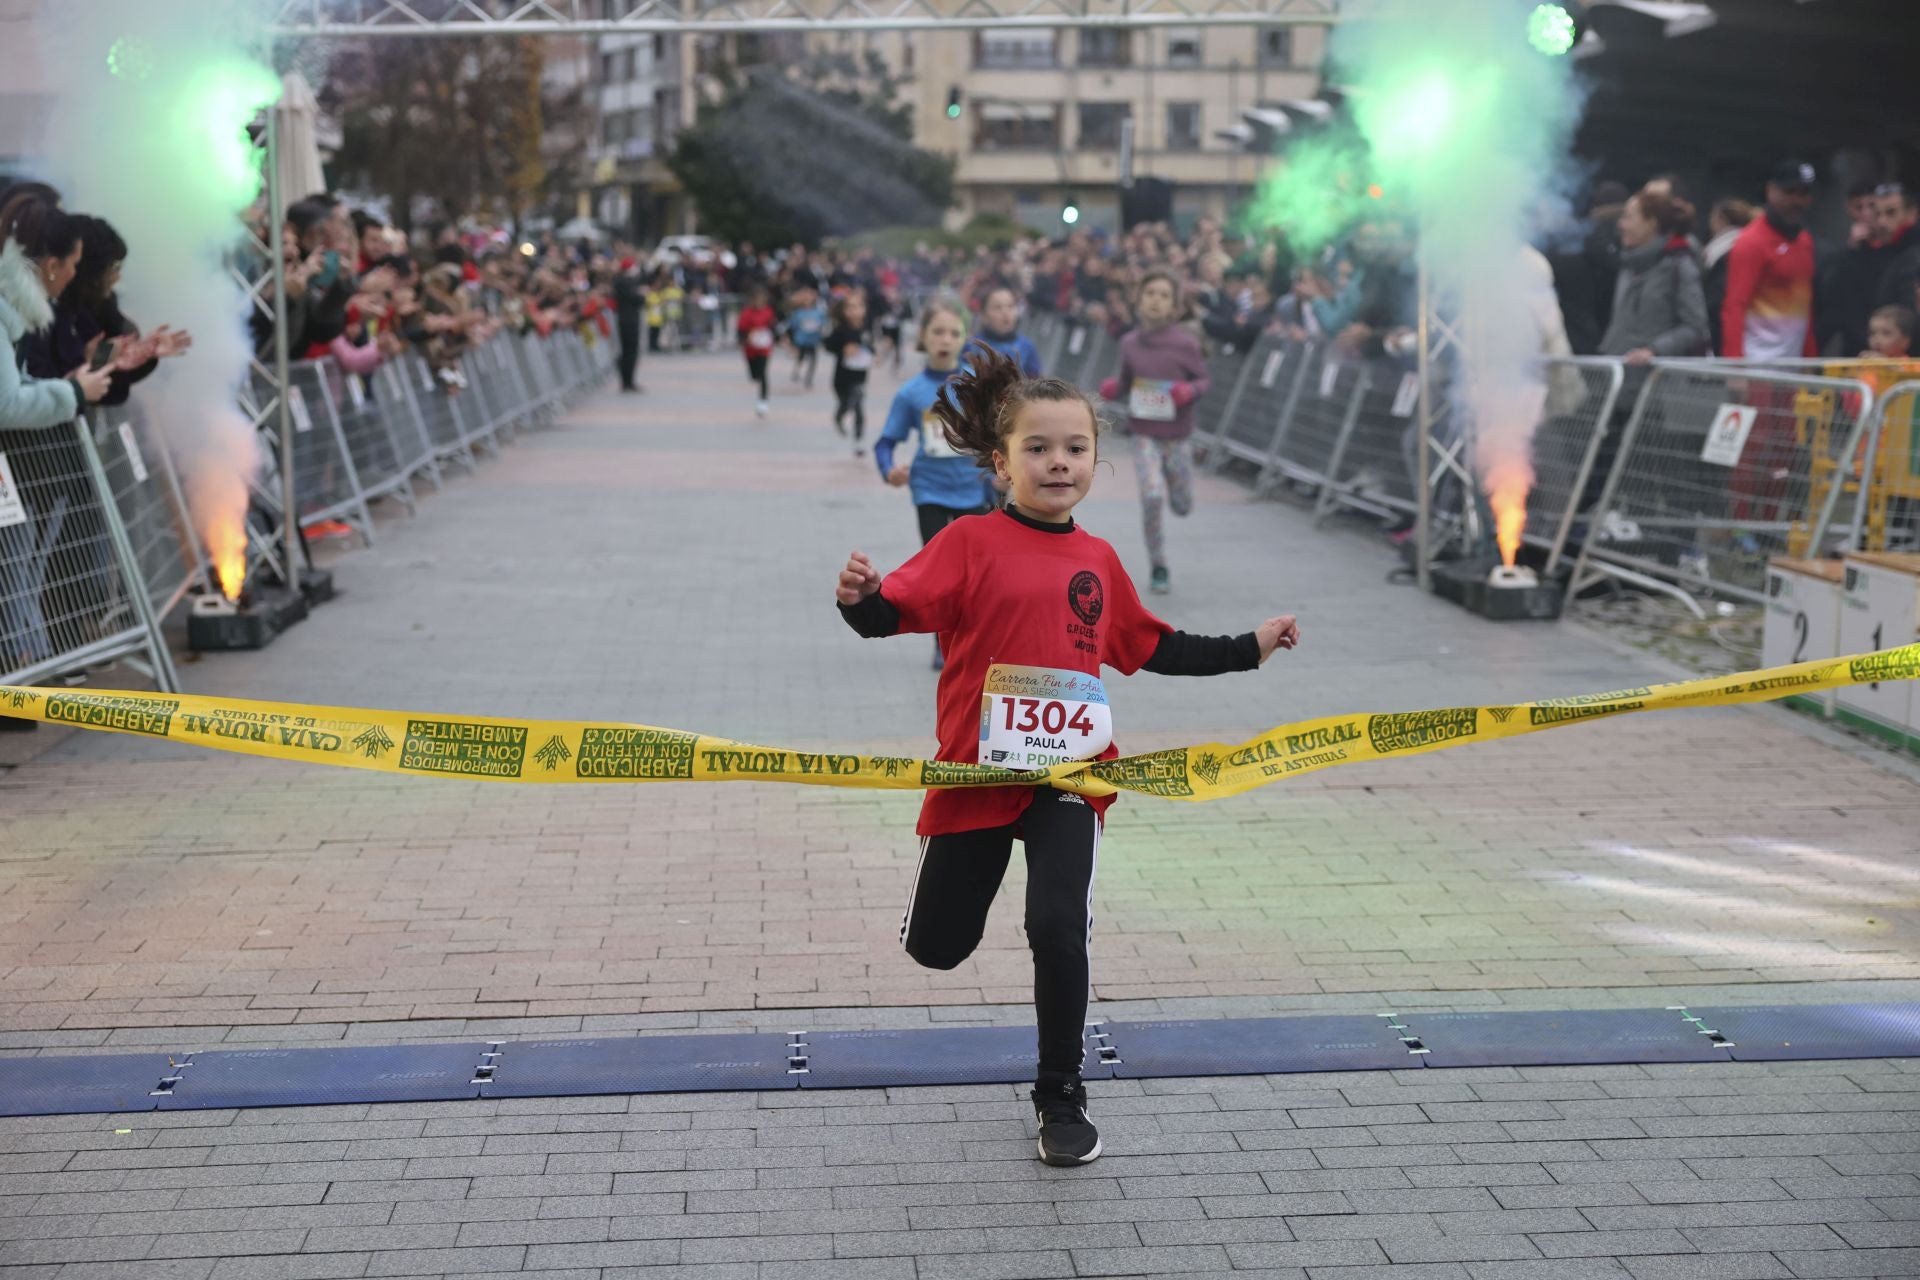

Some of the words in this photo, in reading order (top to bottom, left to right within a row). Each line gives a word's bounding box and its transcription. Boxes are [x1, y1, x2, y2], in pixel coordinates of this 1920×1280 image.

[1793, 609, 1808, 663] 2
[990, 668, 1040, 686] Carrera
[1042, 674, 1062, 688] Fin
[1065, 677, 1077, 691] de
[987, 683, 1000, 692] LA
[1002, 685, 1028, 695] POLA
[1030, 687, 1059, 697] SIERO
[1086, 692, 1105, 702] 2024
[49, 700, 167, 735] FABRICADO
[213, 708, 291, 724] ASTURIAS
[293, 716, 317, 727] DE
[1002, 696, 1094, 737] 1304
[1371, 723, 1400, 740] CON
[1405, 711, 1475, 732] MATERIAL
[181, 713, 269, 742] RURAL
[425, 722, 525, 743] AMBIENTE
[602, 729, 696, 743] RECICLADO
[280, 726, 342, 751] CAJA
[1025, 736, 1067, 750] PAULA
[1229, 740, 1282, 767] CAJA
[1285, 722, 1362, 755] RURAL
[1375, 723, 1457, 752] RECICLADO
[405, 739, 459, 756] MEDIO
[463, 743, 482, 758] EL
[485, 745, 522, 760] CON
[582, 744, 655, 757] MATERIAL
[661, 744, 691, 757] CON
[403, 754, 519, 775] COMPROMETIDOS
[578, 757, 689, 776] FABRICADO
[702, 751, 787, 773] RURAL
[1261, 763, 1282, 776] DE
[1284, 749, 1348, 772] ASTURIAS
[1094, 767, 1123, 781] CON
[1125, 766, 1143, 780] EL
[1144, 763, 1185, 780] MEDIO
[1058, 796, 1085, 805] adidas
